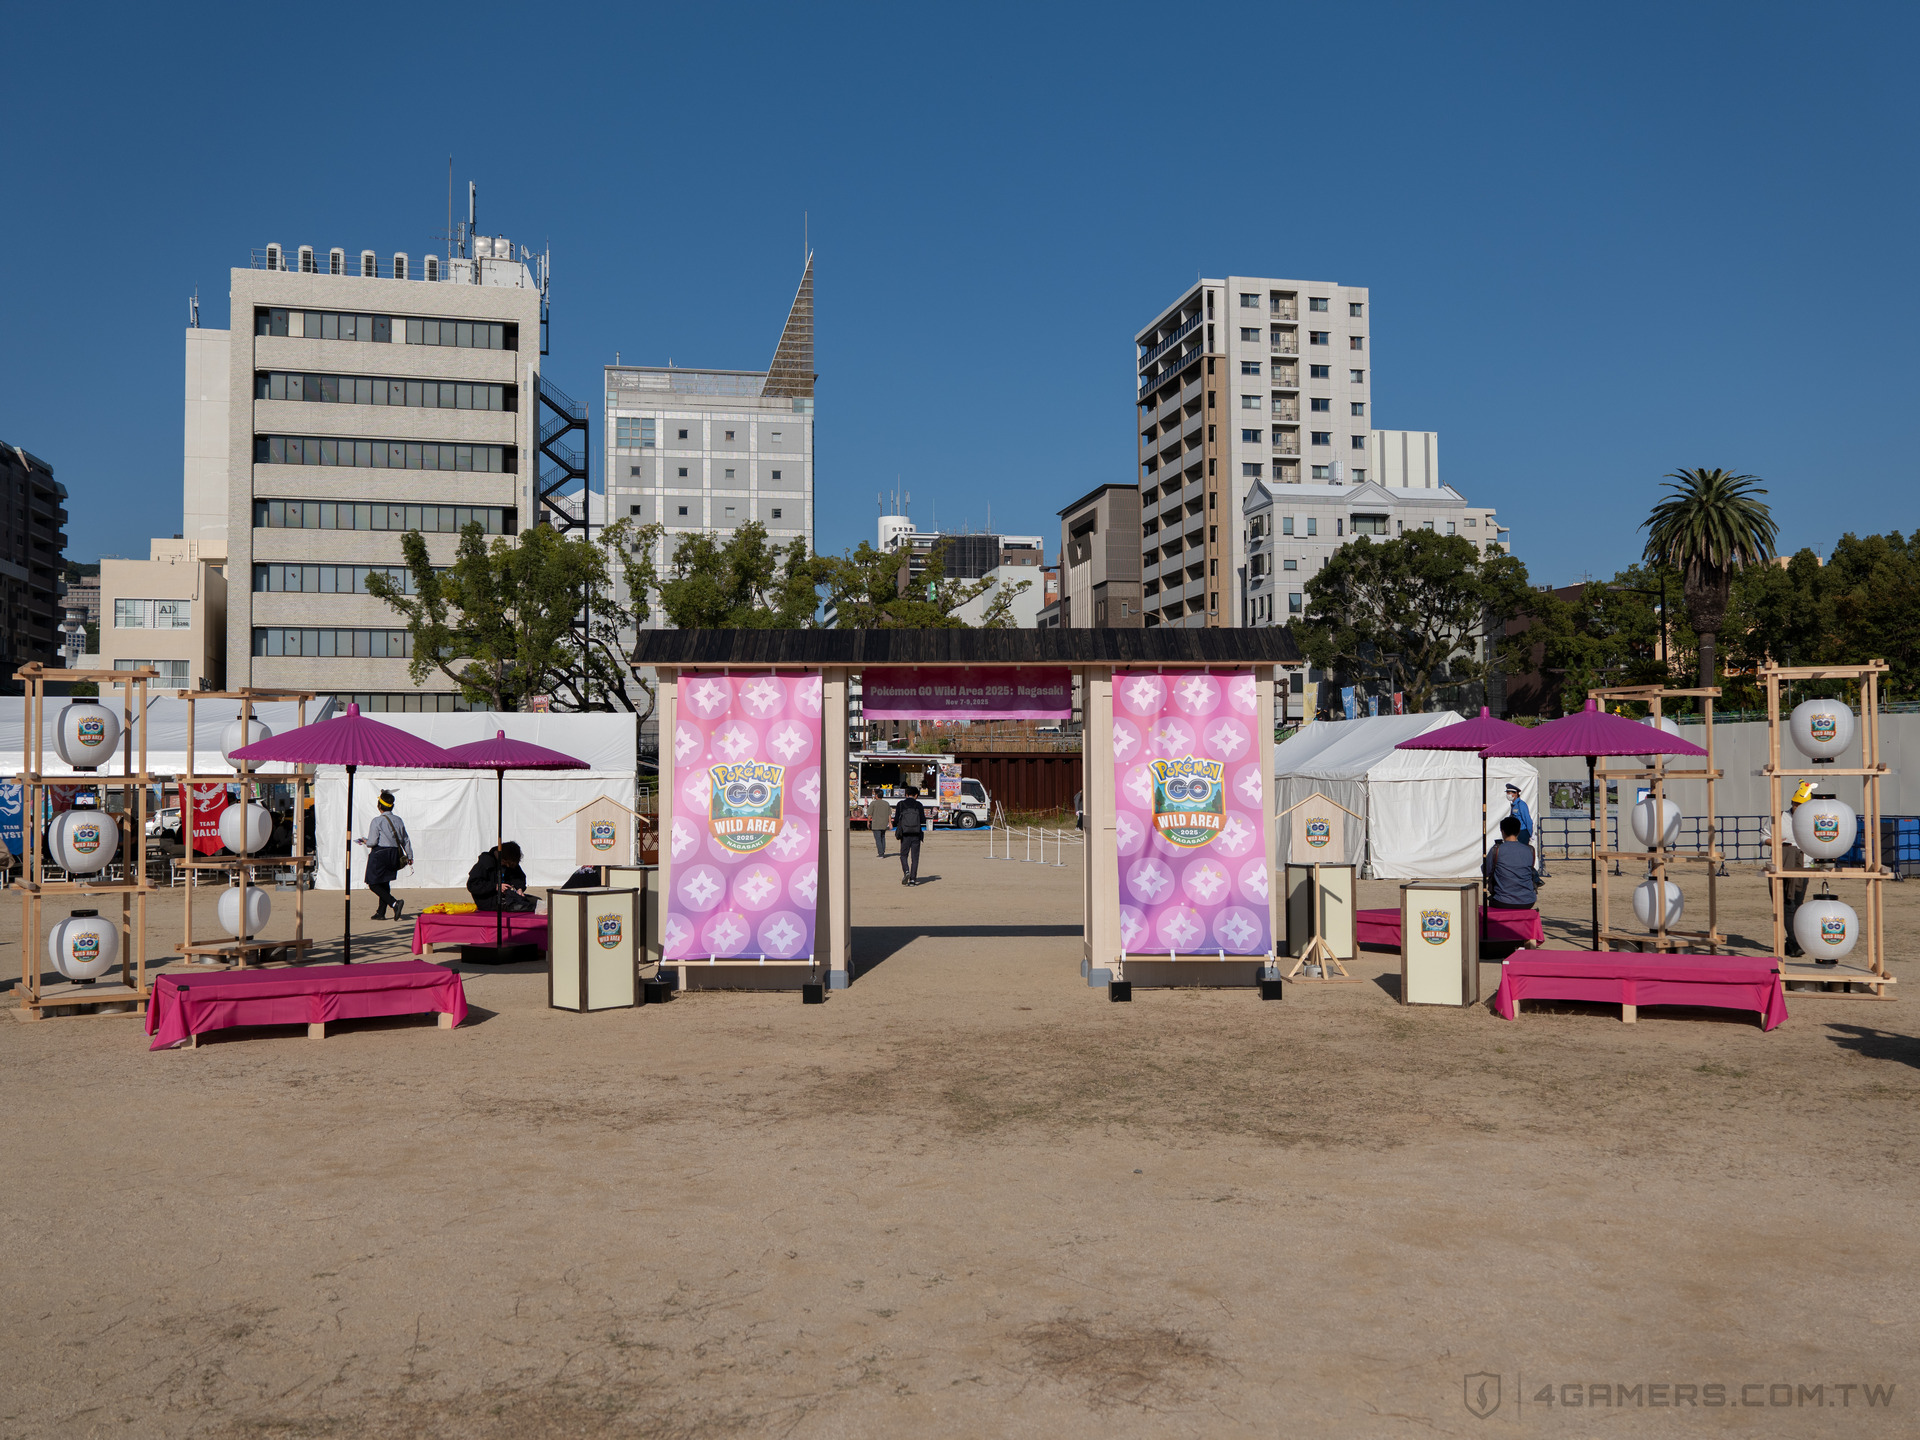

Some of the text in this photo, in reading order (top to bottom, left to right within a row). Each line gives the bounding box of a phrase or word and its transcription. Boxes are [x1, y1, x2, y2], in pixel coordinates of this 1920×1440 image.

[870, 685, 917, 696] Pokémon
[918, 686, 932, 696] GO
[934, 686, 957, 696] Wild
[959, 686, 984, 696] Area
[1017, 686, 1064, 698] Nagasaki
[727, 783, 768, 804] GO
[1167, 778, 1210, 800] GO
[714, 818, 777, 834] WILD AREA
[1157, 814, 1220, 829] WILD AREA
[726, 840, 764, 850] NAGASAKI
[1170, 835, 1209, 845] NAGASAKI
